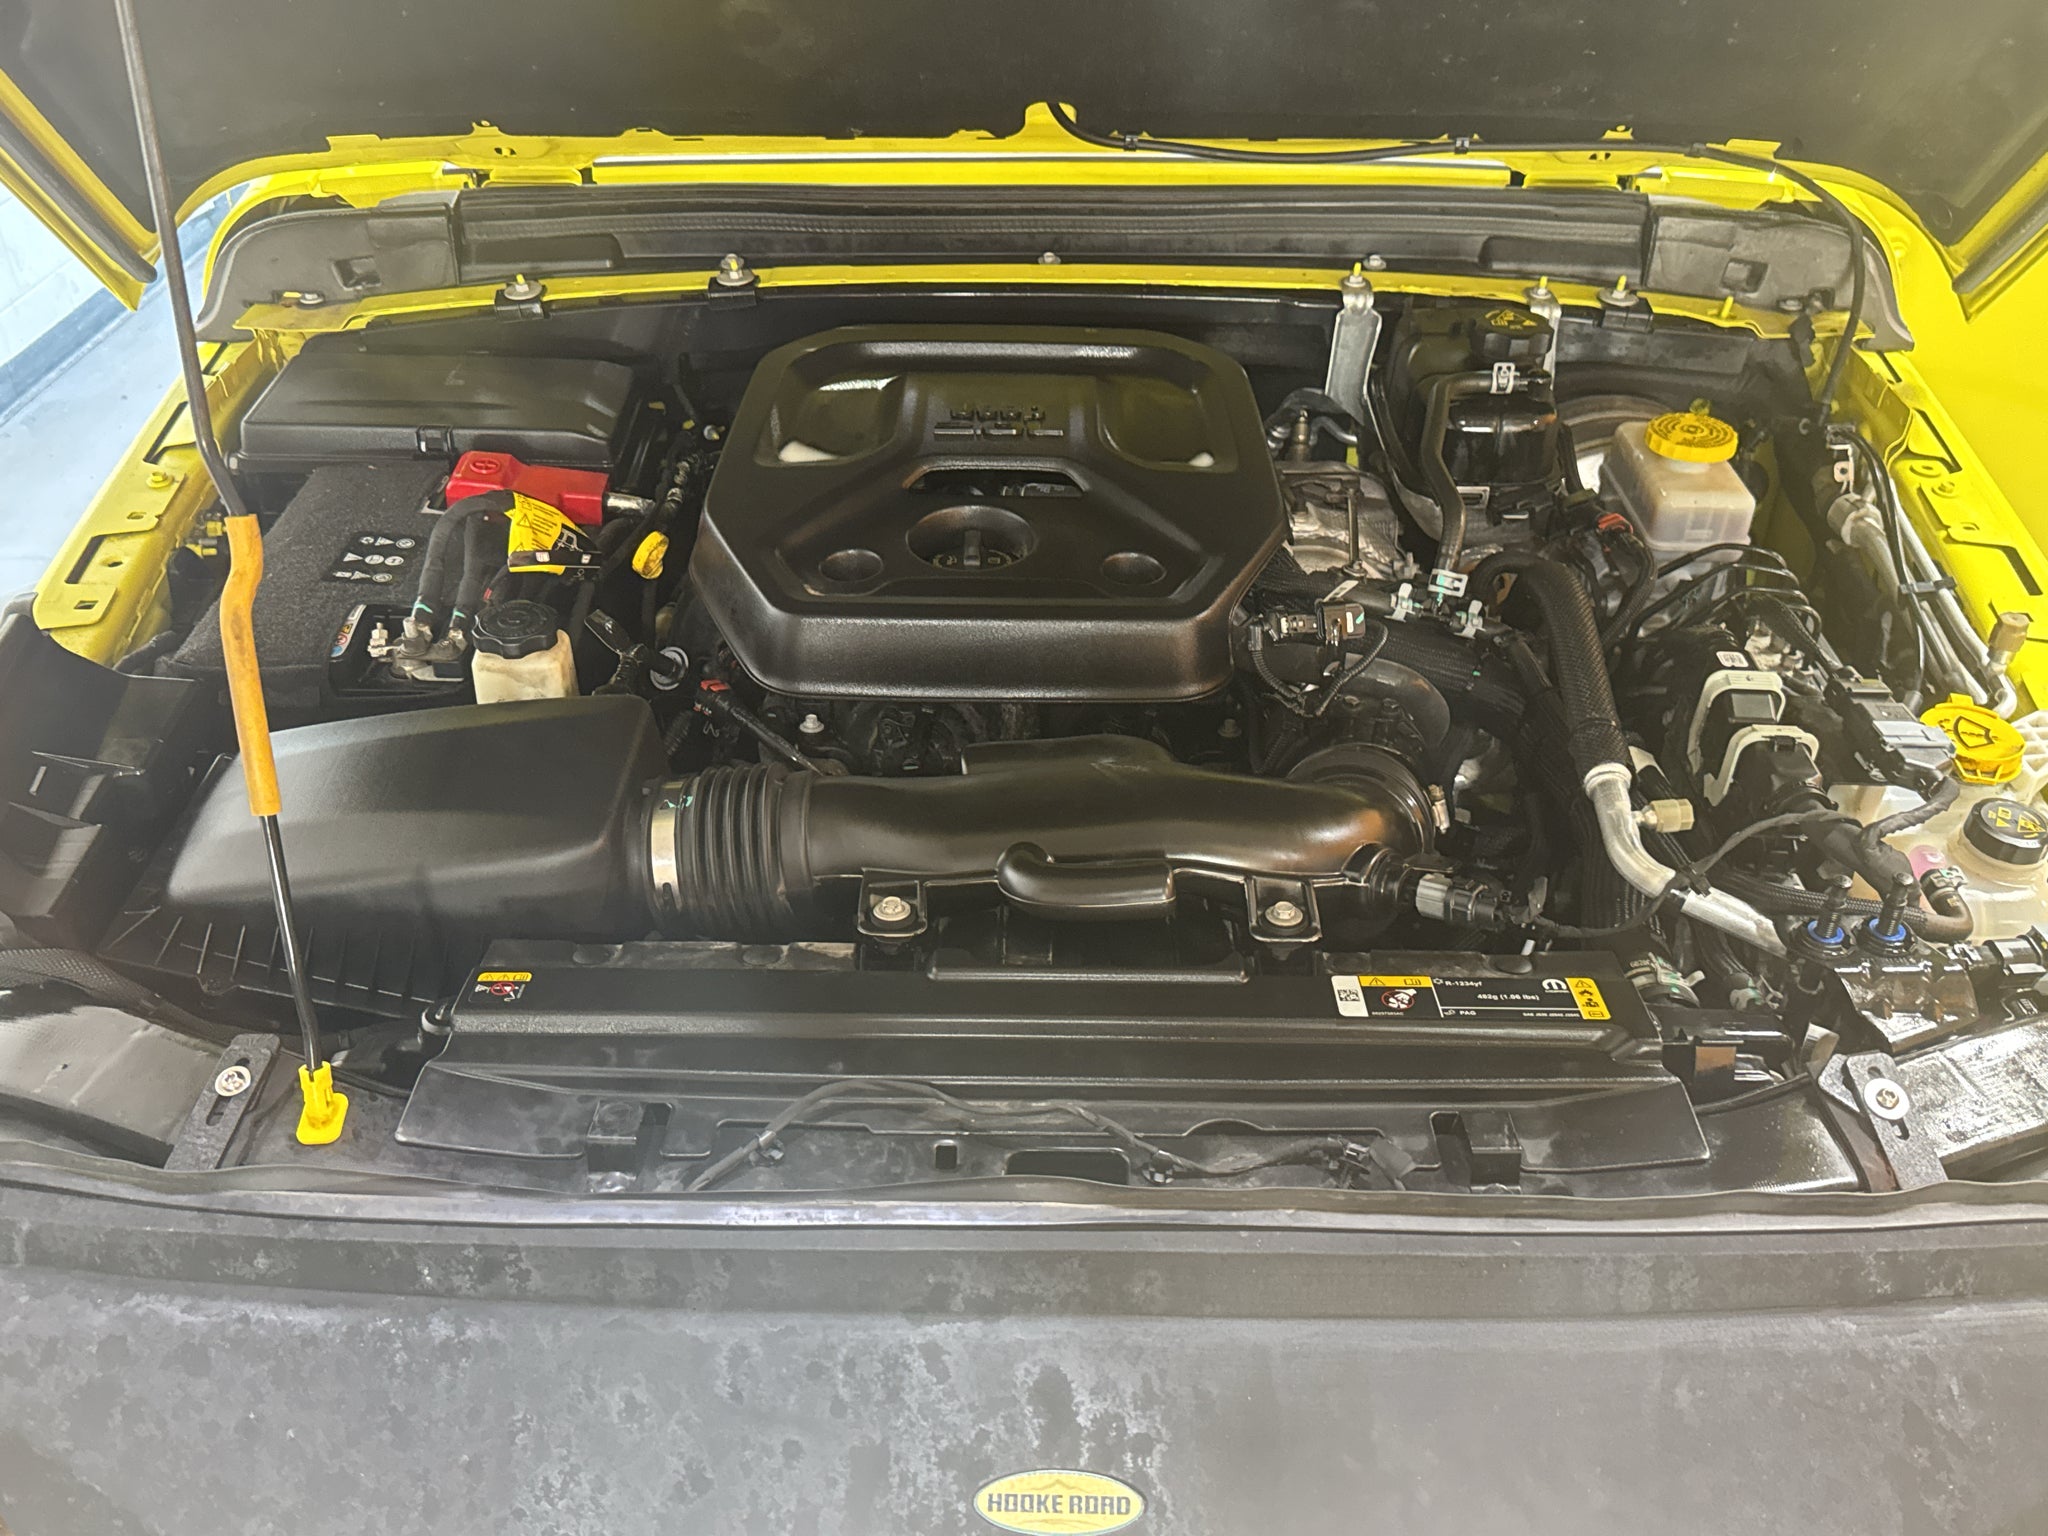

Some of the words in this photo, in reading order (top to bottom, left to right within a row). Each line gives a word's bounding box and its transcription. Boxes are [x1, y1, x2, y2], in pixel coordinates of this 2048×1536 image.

[1445, 980, 1483, 988] R-1234yf
[987, 1493, 1063, 1514] HOOKE
[1069, 1495, 1131, 1515] ROAD
